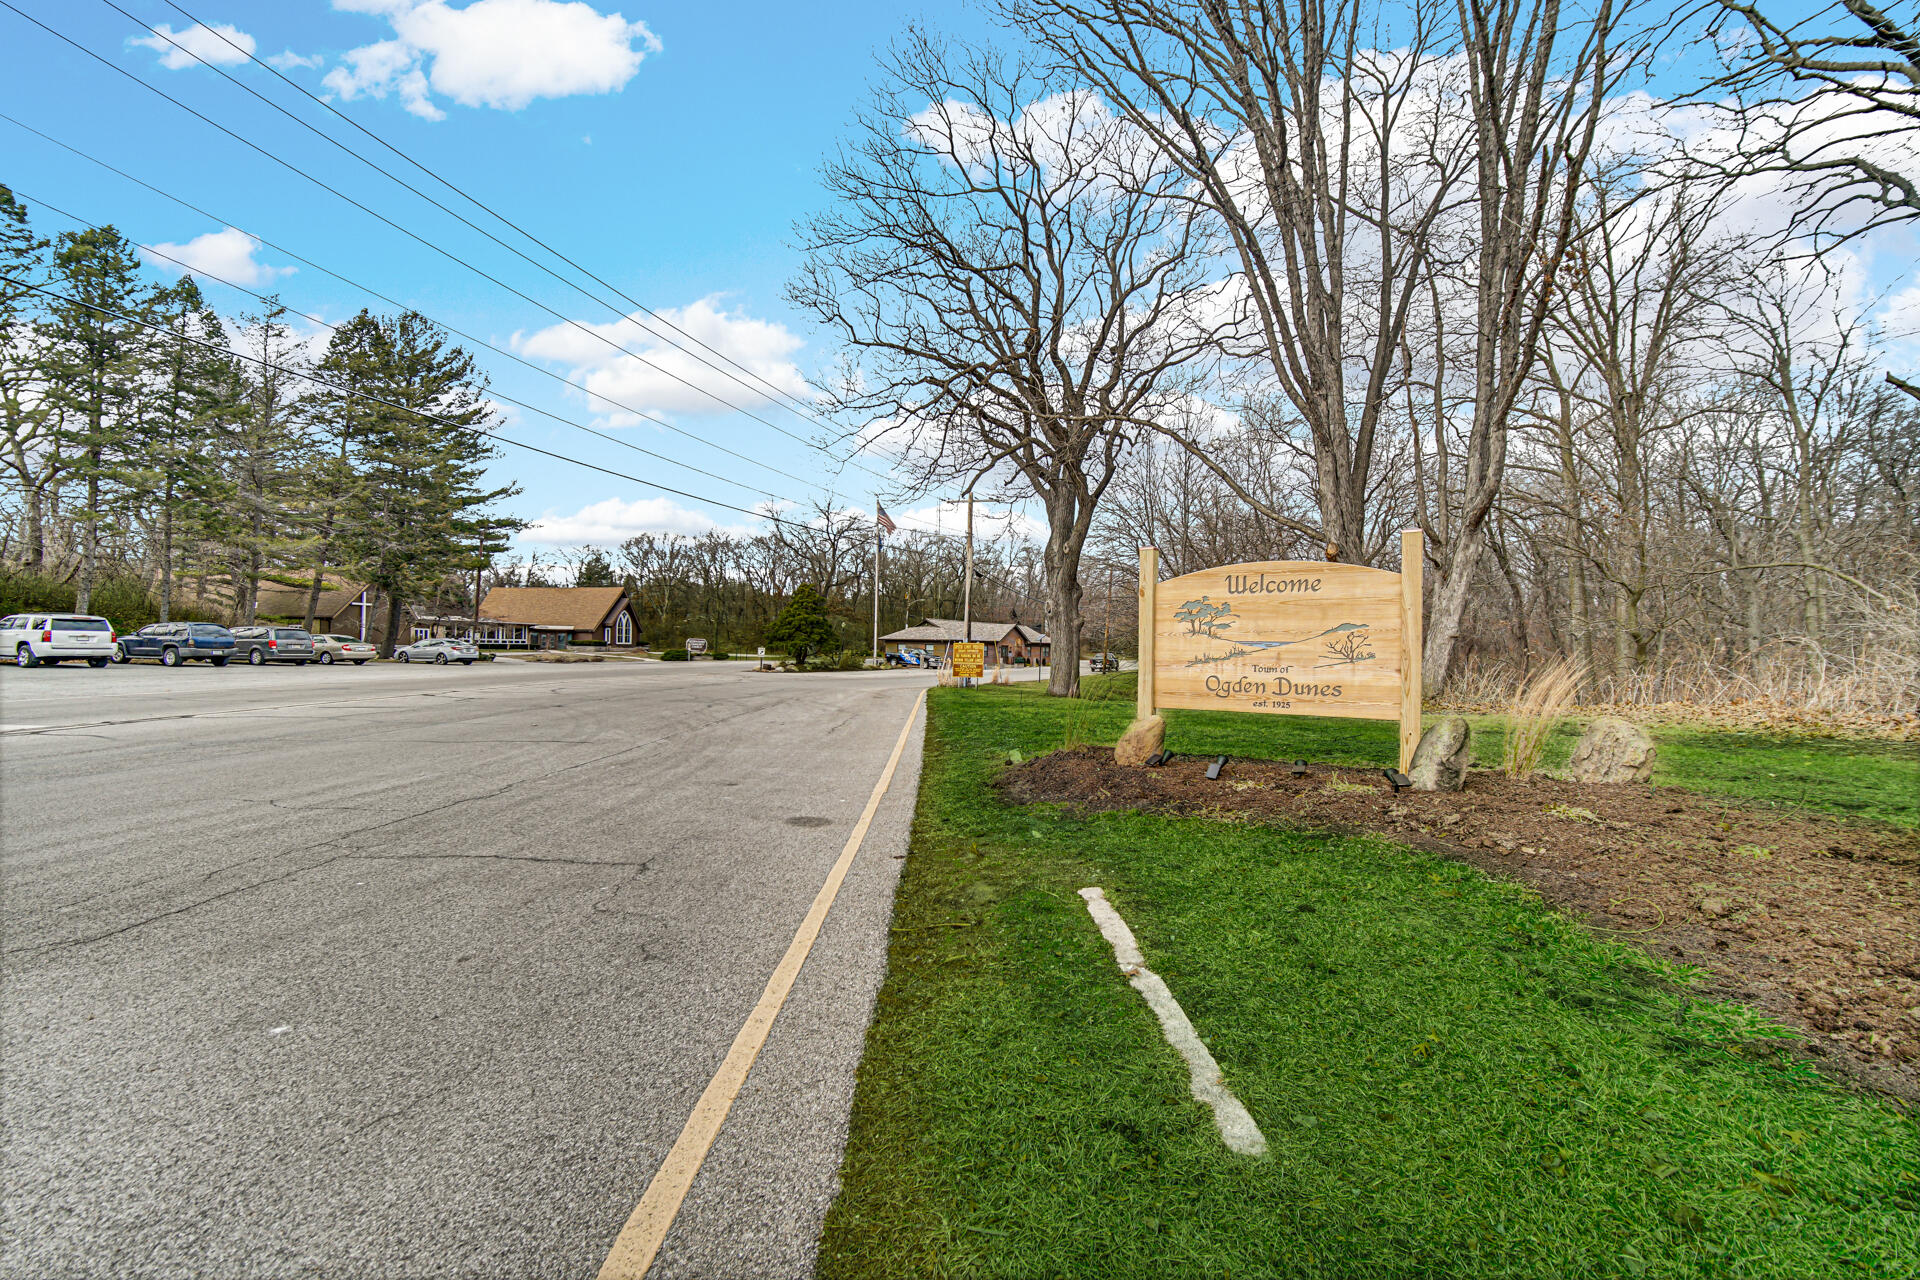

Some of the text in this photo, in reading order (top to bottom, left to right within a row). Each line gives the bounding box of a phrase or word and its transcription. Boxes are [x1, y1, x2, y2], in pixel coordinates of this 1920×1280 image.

[1224, 573, 1322, 595] Welcome
[1251, 664, 1294, 674] Town of
[1205, 675, 1343, 698] Ogden Dunes
[1252, 700, 1292, 709] est. 1925
